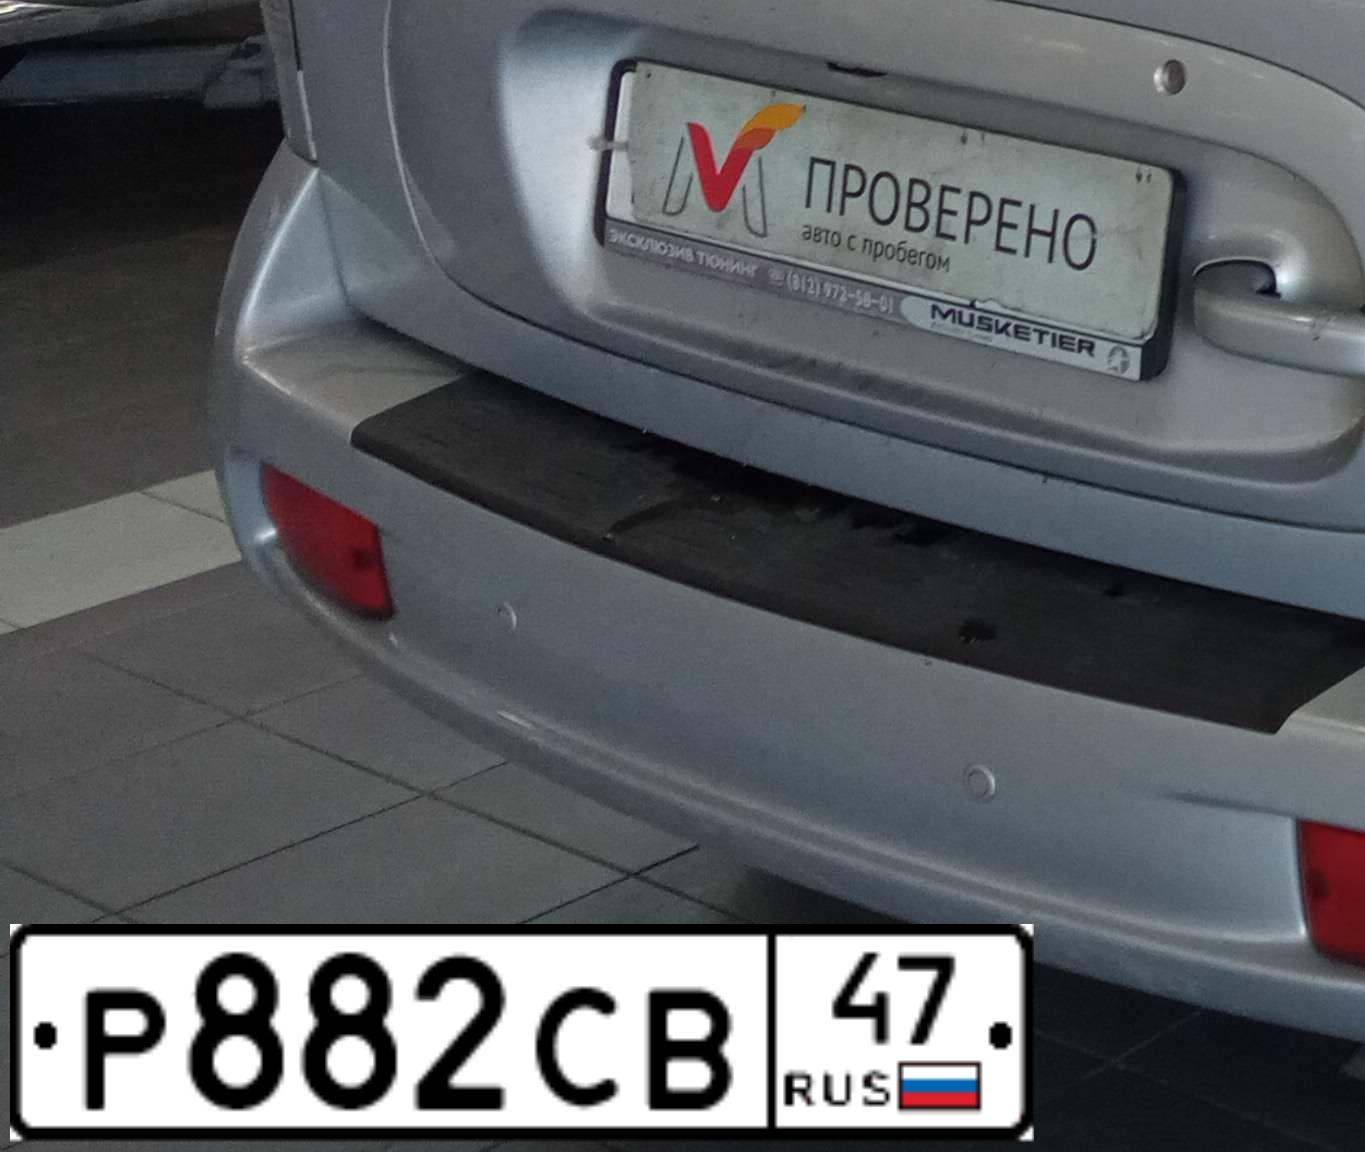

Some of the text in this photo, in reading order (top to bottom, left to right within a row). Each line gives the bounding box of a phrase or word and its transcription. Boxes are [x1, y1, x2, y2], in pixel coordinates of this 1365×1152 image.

[804, 156, 1098, 272] ПРОВЕРЕНО
[608, 228, 759, 278] ЭКСКЛЮЗИВ ТЮНИНГ
[802, 223, 950, 273] авто с пробегом
[930, 303, 1096, 358] MUSKETIER
